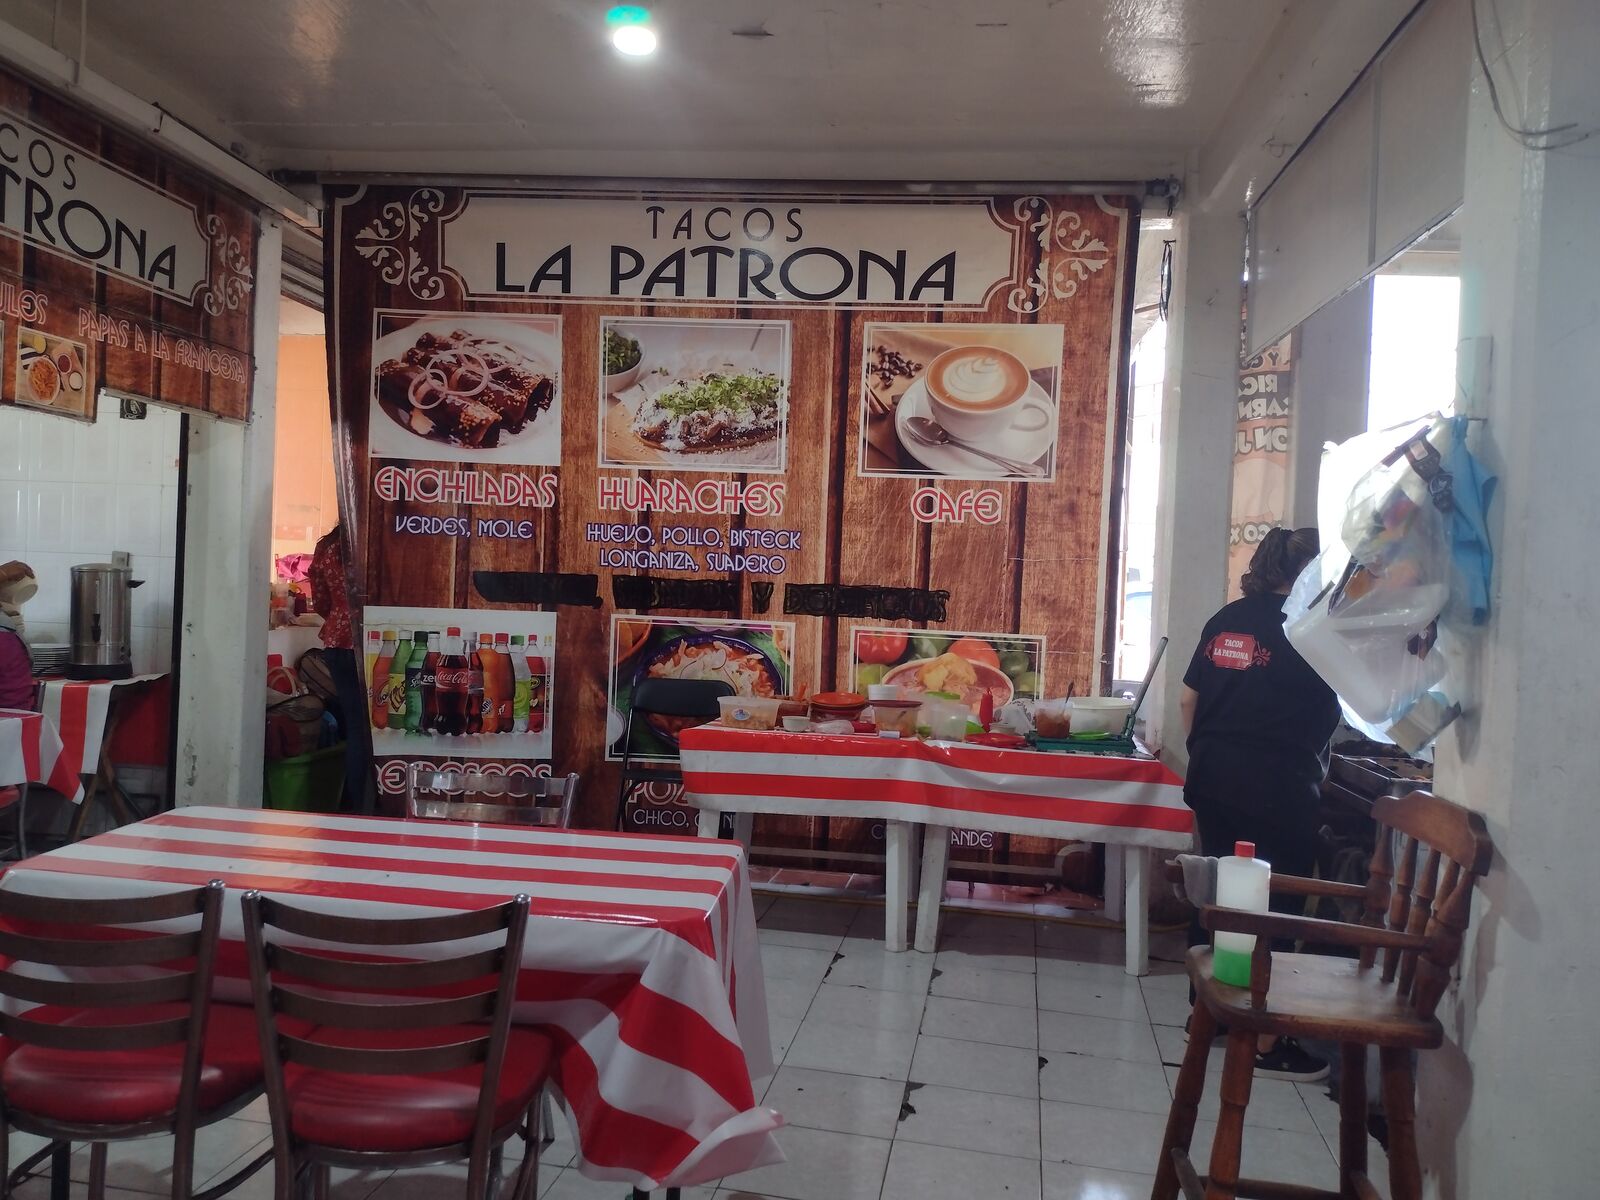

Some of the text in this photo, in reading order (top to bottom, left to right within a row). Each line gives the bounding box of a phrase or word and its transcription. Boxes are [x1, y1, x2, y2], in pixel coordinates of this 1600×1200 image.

[646, 206, 803, 242] TACOS
[496, 242, 957, 301] LA PATRONA
[79, 307, 246, 383] PAPAS A LA FRANCESA
[374, 466, 558, 507] ENCHILADAS
[599, 476, 786, 517] HUARACHES
[910, 487, 1002, 526] CAFE
[395, 515, 533, 539] VERDES, MOLE
[586, 523, 801, 550] HUEVO, POLLO, BISTECK
[600, 549, 787, 574] LONGANIZA, SUADERO
[1213, 648, 1249, 660] LA PATRONA
[1224, 639, 1244, 649] TACOS
[633, 809, 690, 828] CHICO,
[951, 830, 993, 850] ANDE
